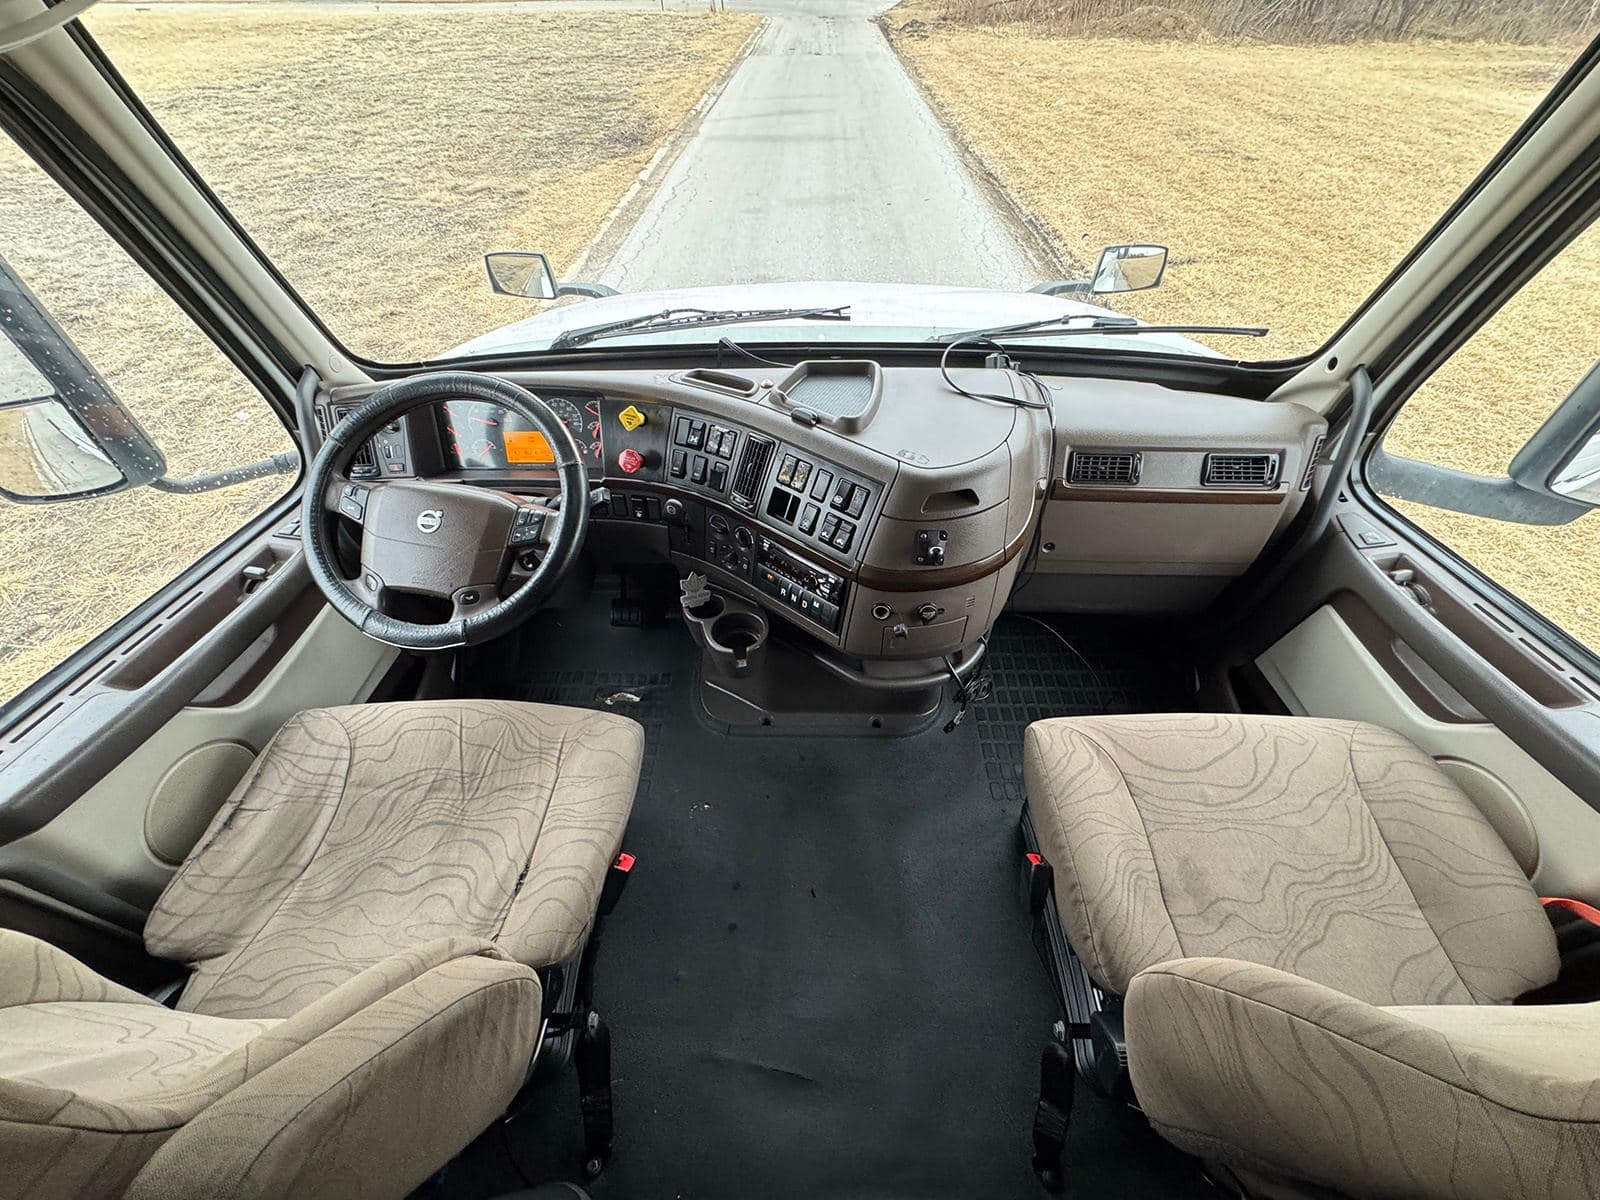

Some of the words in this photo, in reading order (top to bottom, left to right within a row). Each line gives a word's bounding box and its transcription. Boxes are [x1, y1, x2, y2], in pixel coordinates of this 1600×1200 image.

[780, 588, 787, 596] R
[791, 593, 797, 602] N
[801, 600, 808, 608] D
